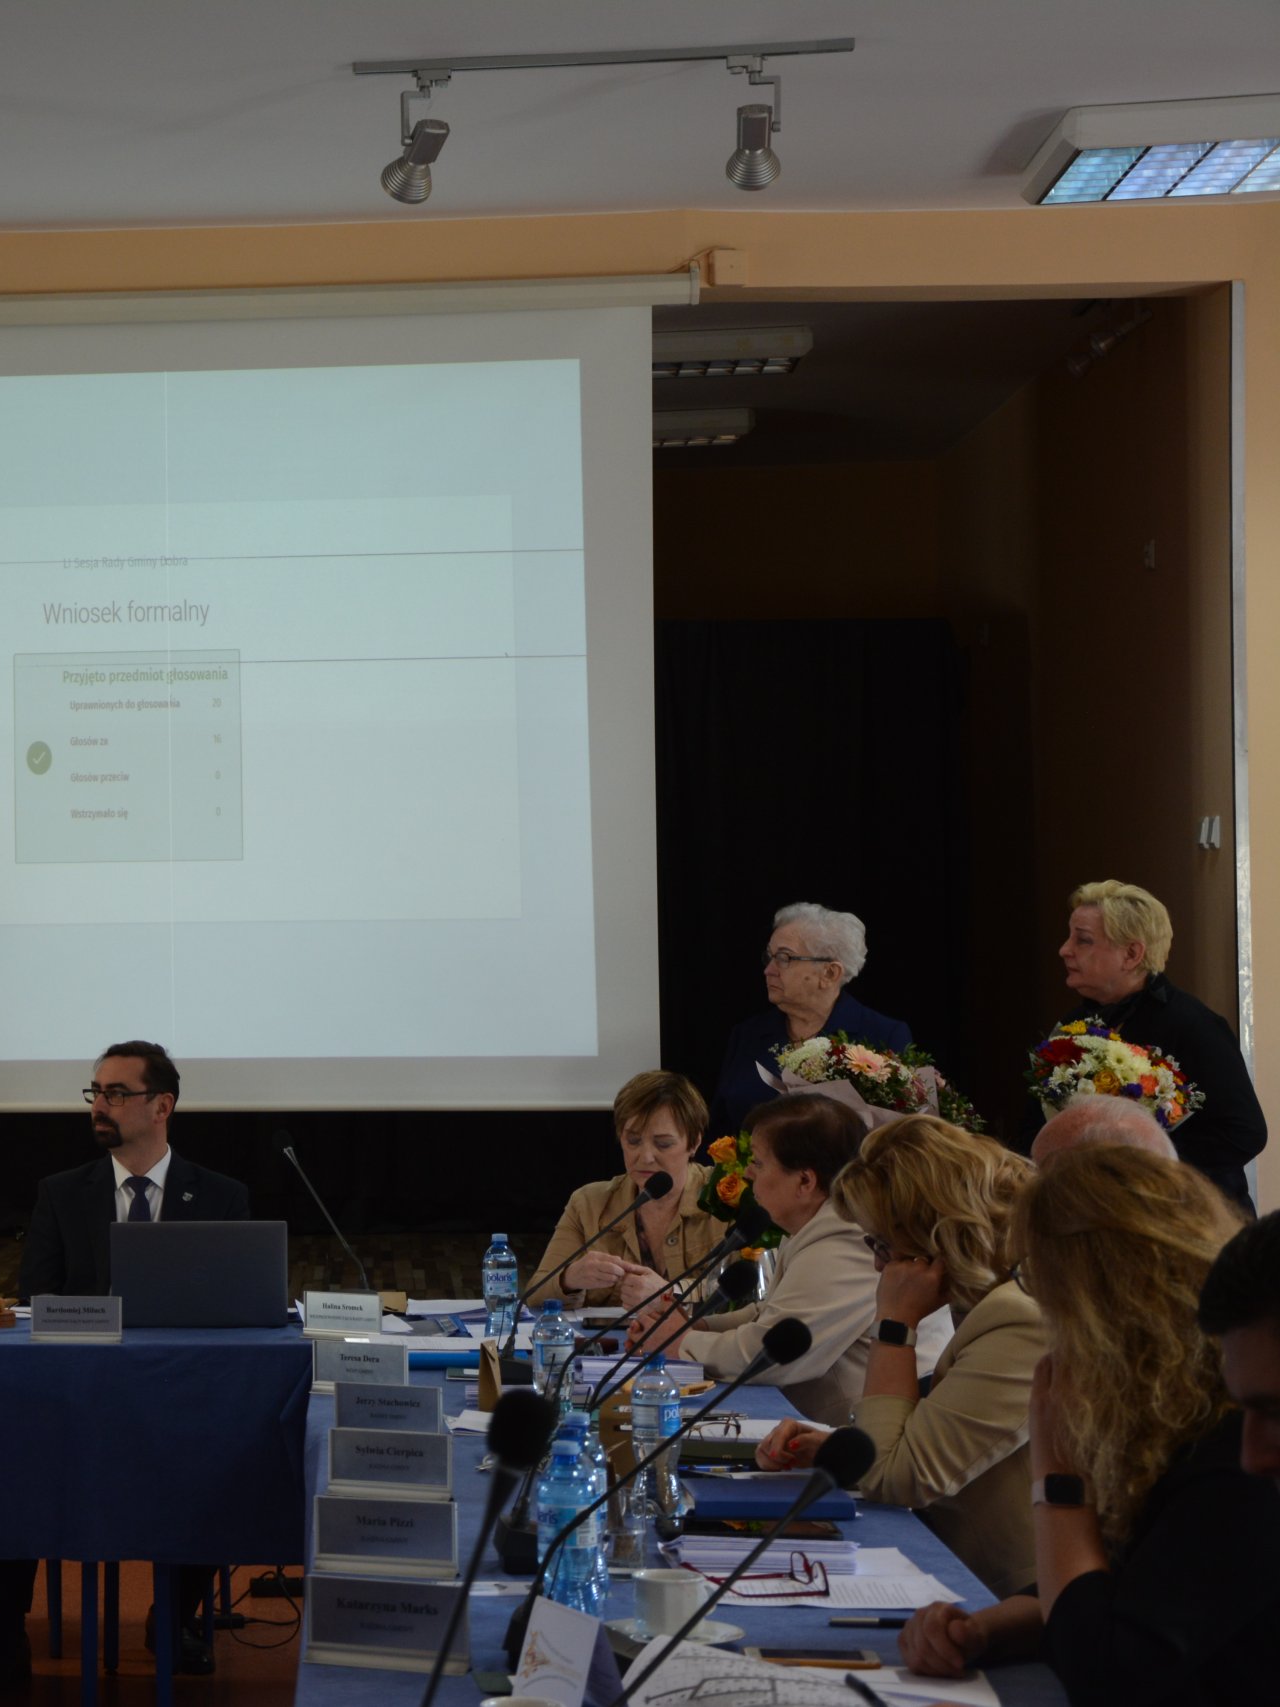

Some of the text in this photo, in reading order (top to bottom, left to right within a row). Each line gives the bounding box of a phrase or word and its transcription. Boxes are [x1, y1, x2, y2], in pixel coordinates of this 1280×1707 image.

[101, 556, 125, 570] Rady
[127, 556, 157, 569] Gminy
[160, 554, 189, 567] Dobra
[43, 598, 210, 627] Wniosek formalny
[62, 665, 229, 687] Przyjęto przedmiot głosowania
[69, 698, 123, 713] Uprawnionych
[125, 698, 136, 710] do
[100, 770, 130, 784] przeciw
[339, 1353, 362, 1362] Teresa
[355, 1445, 384, 1456] Sylwia
[356, 1515, 387, 1527] Maria
[336, 1598, 439, 1615] Katarzyna Marks
